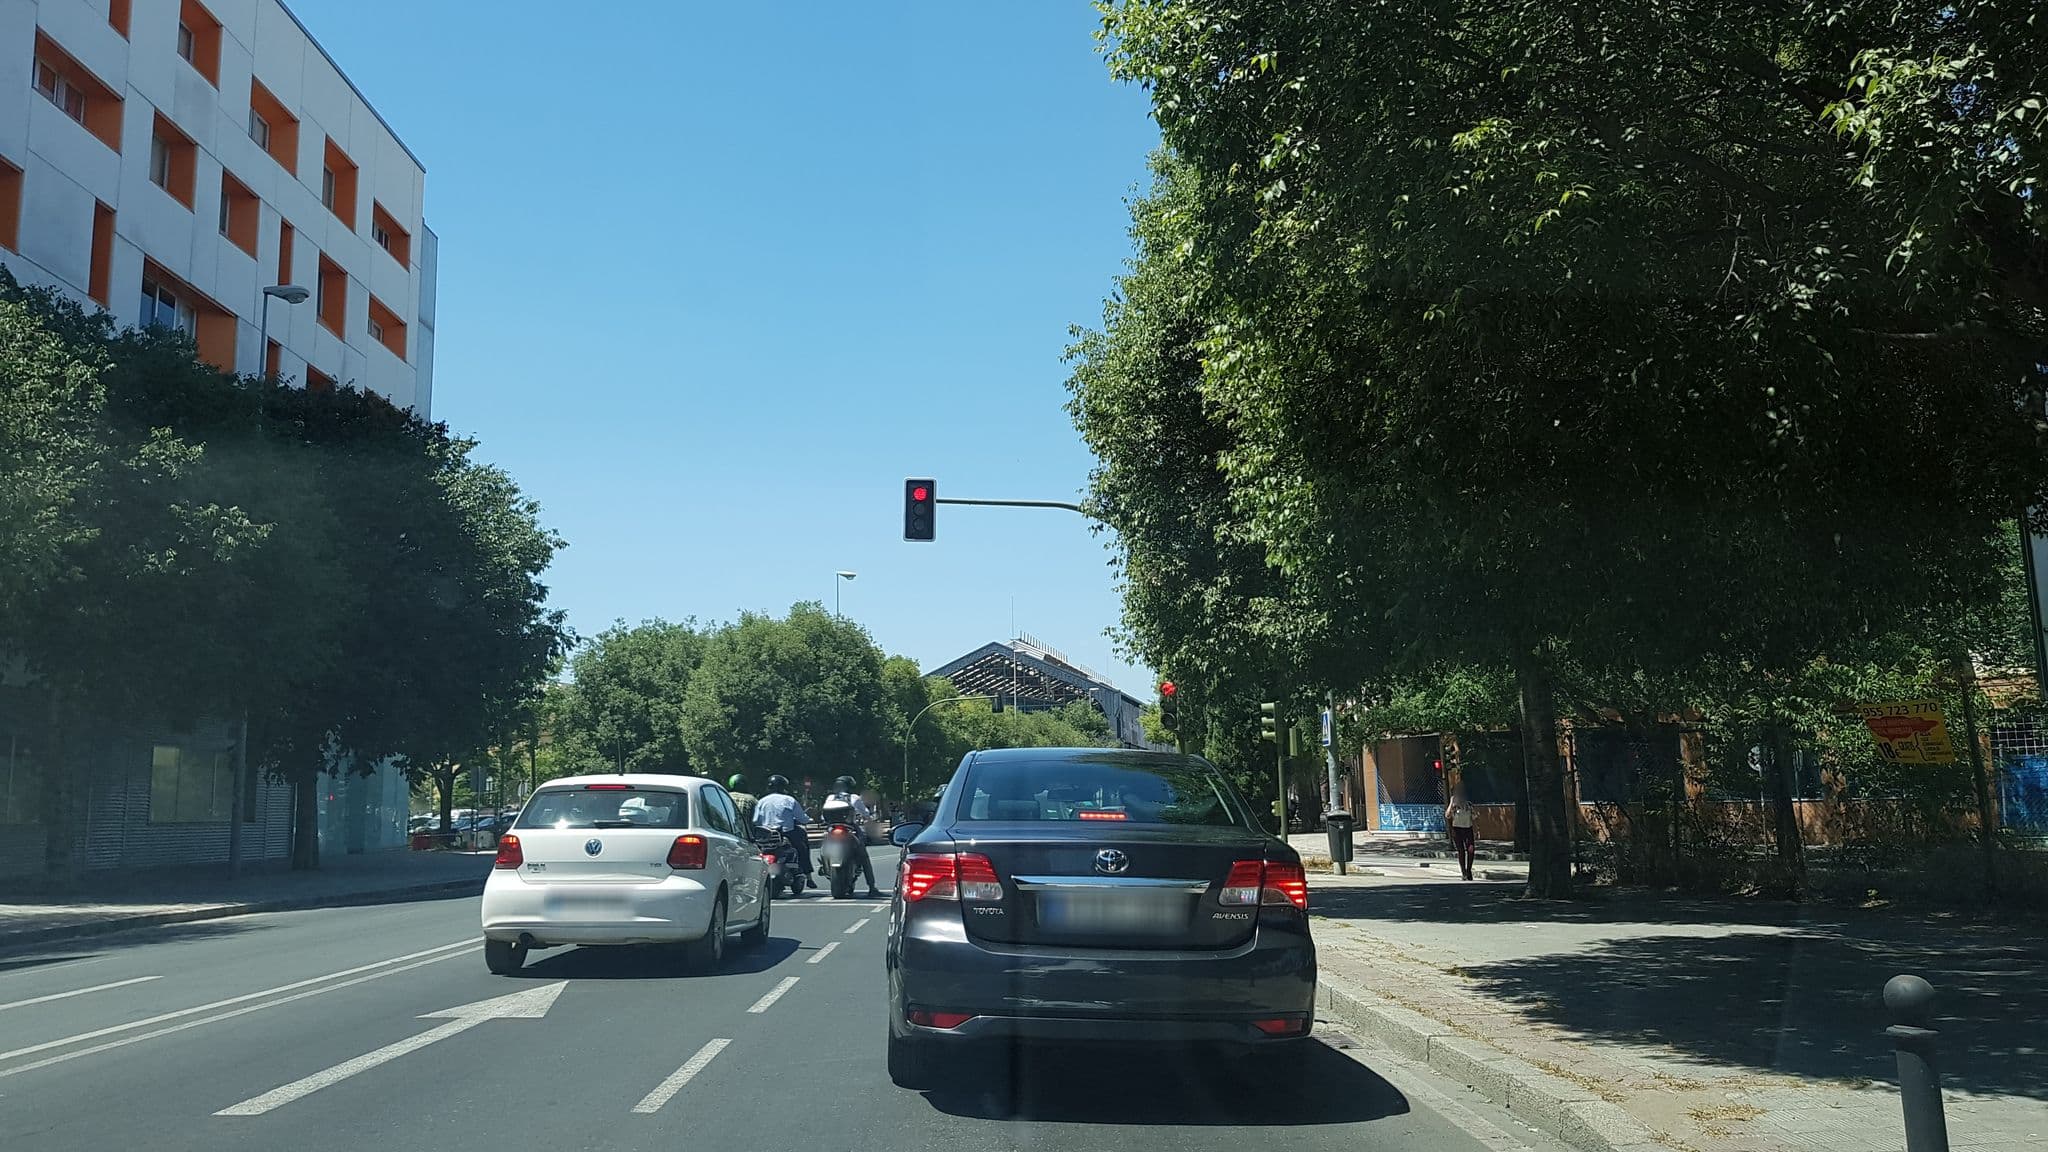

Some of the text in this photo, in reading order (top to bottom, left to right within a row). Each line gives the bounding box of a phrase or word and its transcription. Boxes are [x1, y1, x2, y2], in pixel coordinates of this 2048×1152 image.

[1862, 702, 1938, 717] 955 723 770
[973, 907, 1004, 915] TOYOTA
[1212, 912, 1249, 920] AVENSIS
